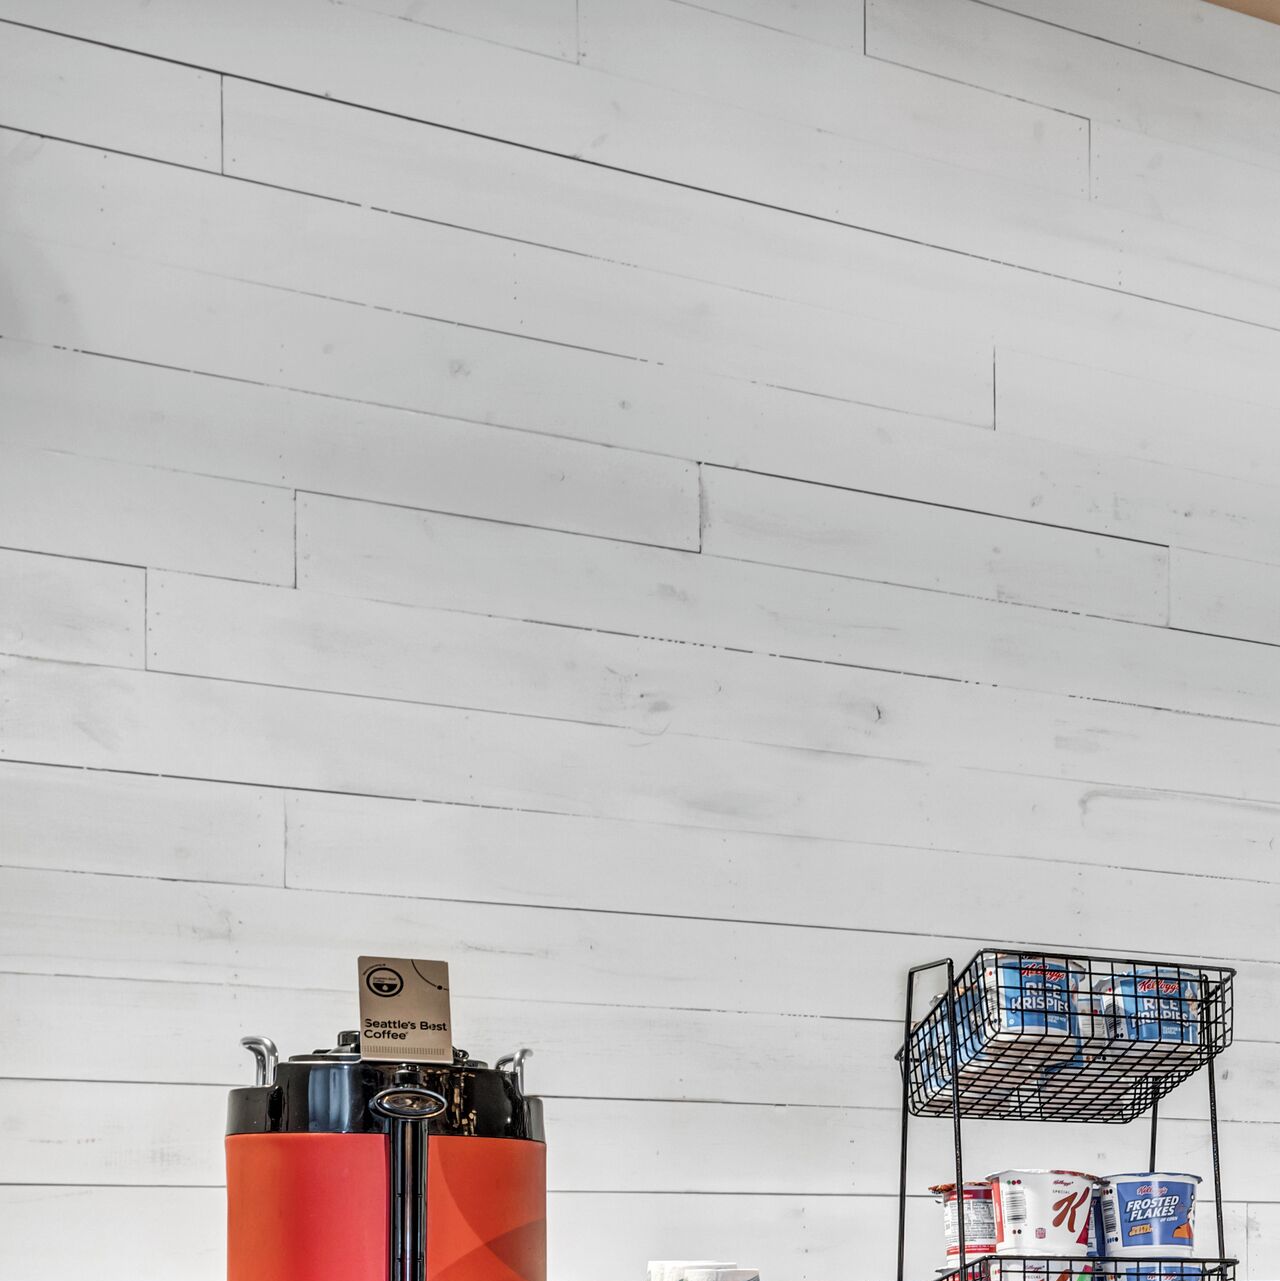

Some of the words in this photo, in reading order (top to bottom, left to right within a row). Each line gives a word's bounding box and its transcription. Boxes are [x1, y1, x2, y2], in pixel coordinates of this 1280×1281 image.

[364, 1018, 416, 1030] Seattle's
[420, 1021, 448, 1031] Best
[363, 1029, 407, 1040] Coffee
[1052, 1187, 1090, 1233] K
[1126, 1196, 1179, 1212] FROSTED
[1130, 1206, 1175, 1221] FLAKES
